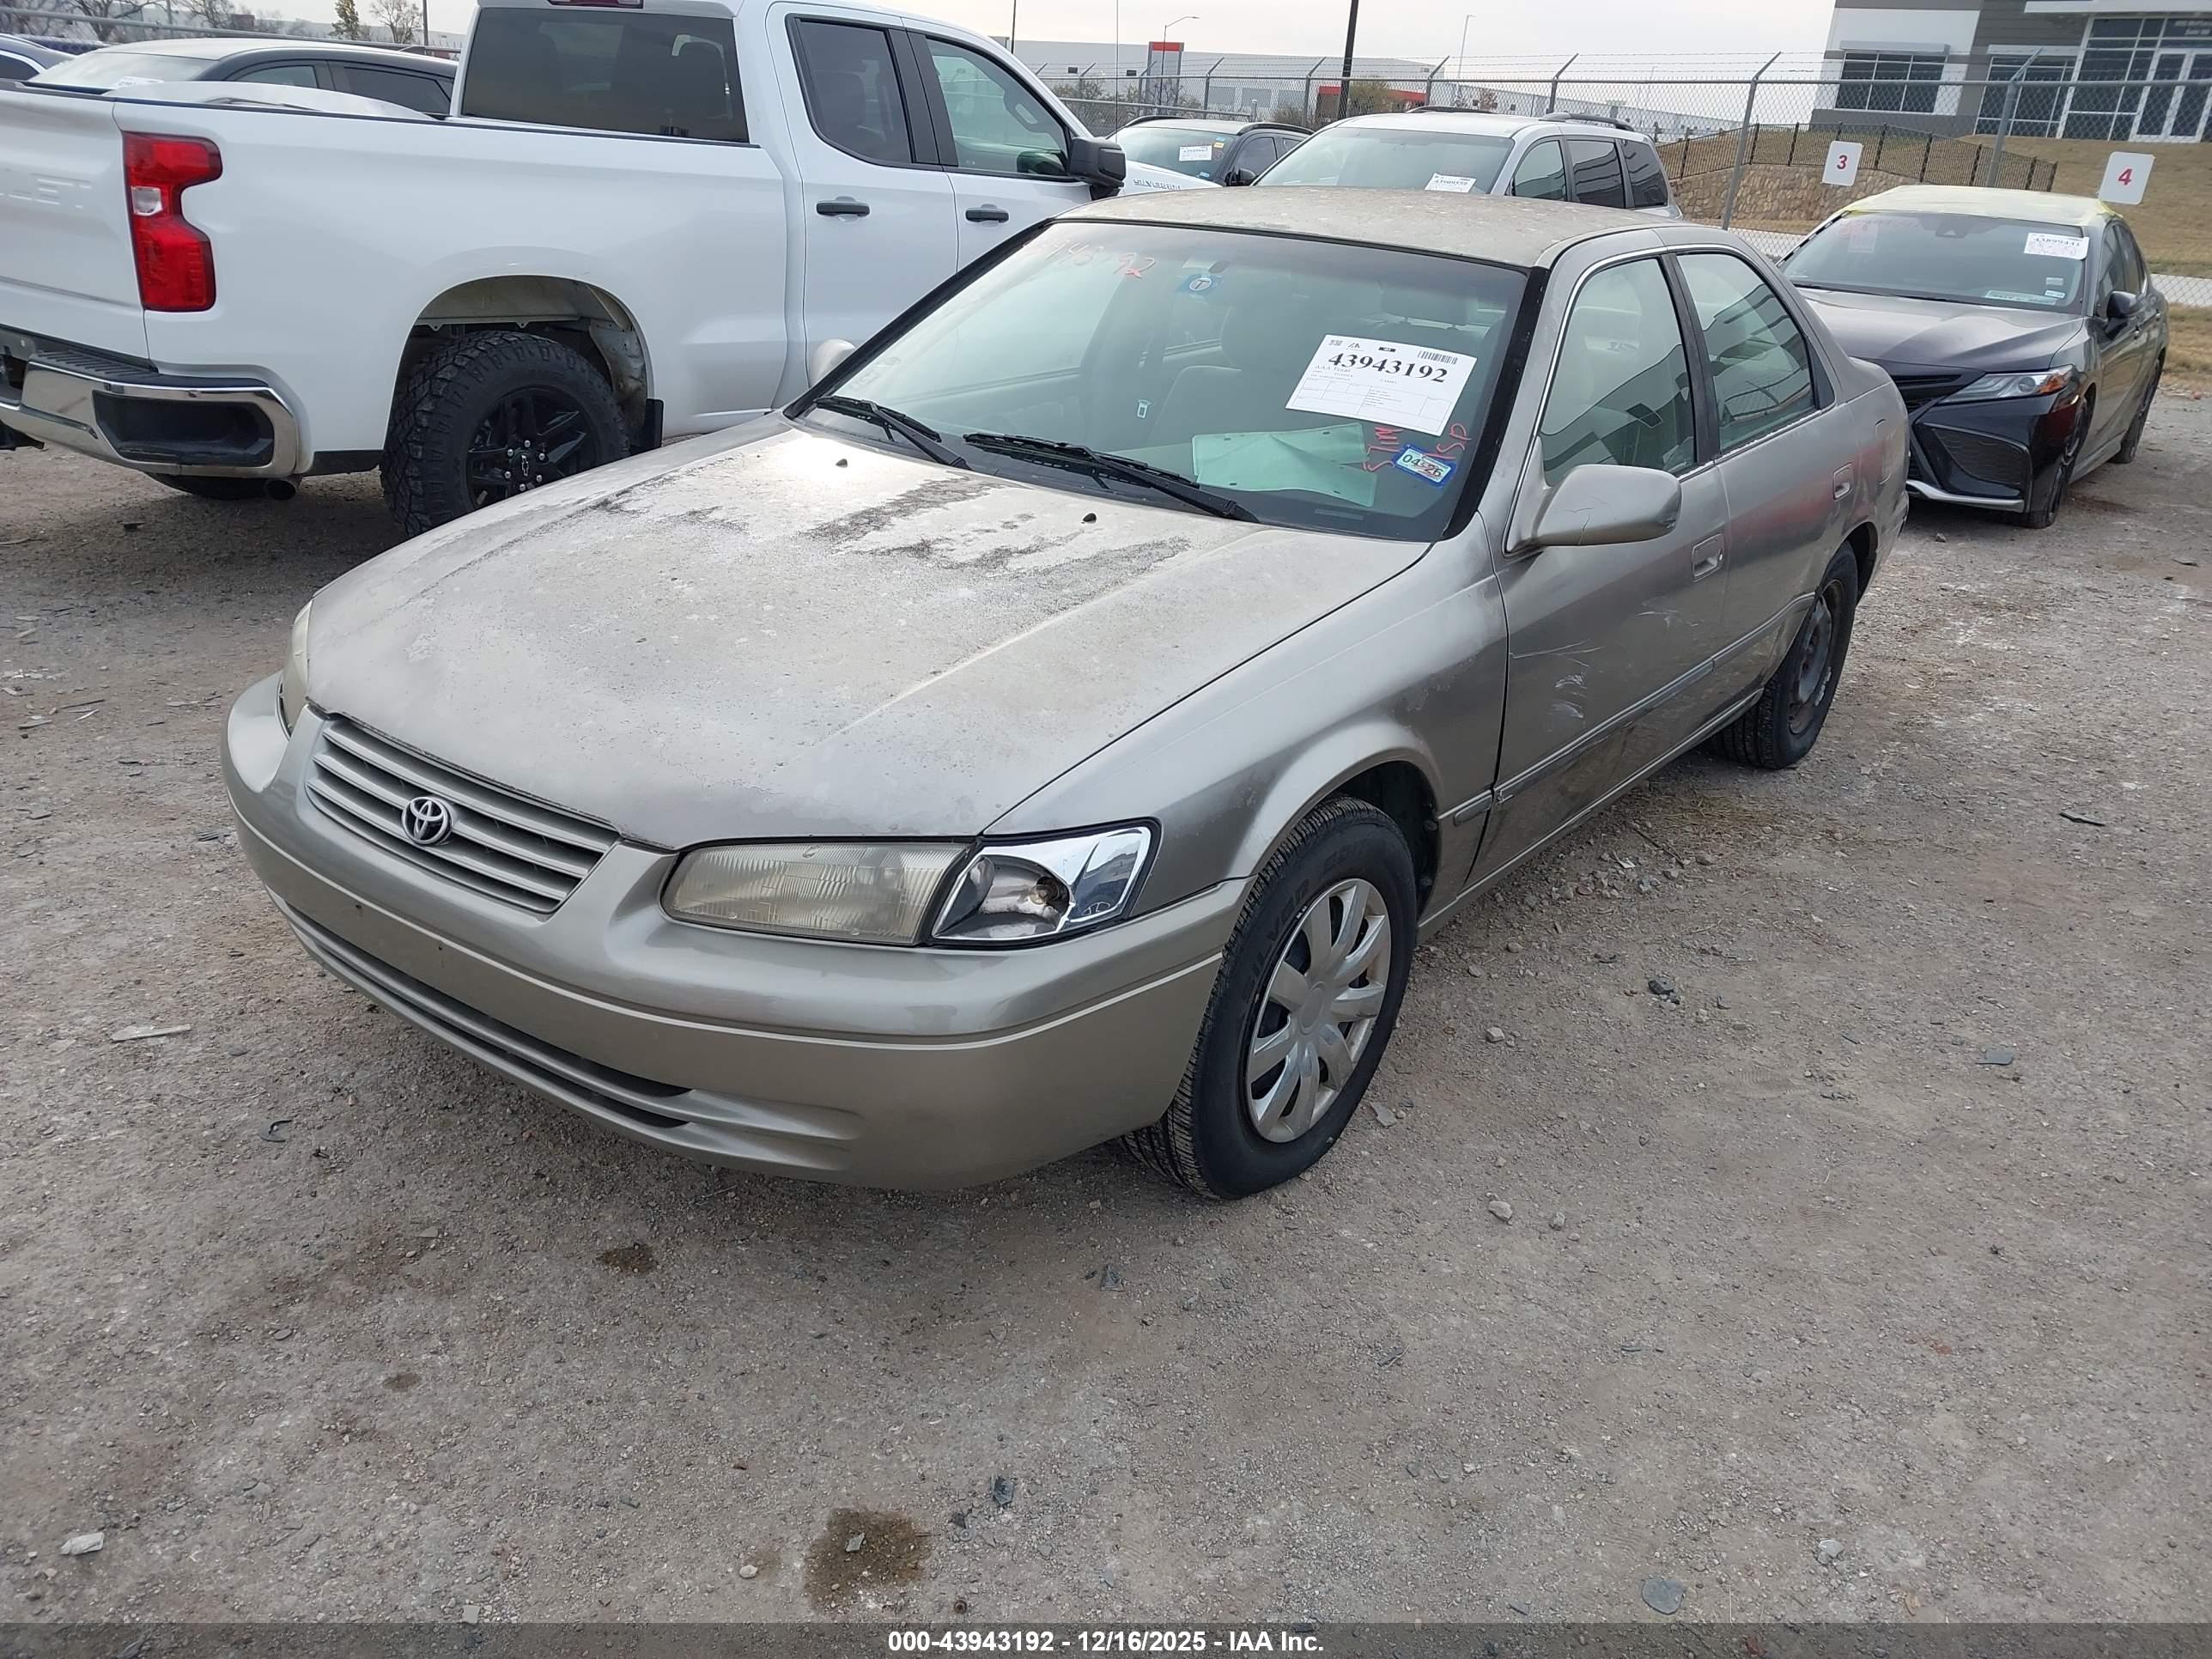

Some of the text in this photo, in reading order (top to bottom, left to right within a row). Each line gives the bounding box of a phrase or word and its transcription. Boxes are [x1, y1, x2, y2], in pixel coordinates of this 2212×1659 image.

[1837, 155, 1848, 170] 3
[2118, 168, 2133, 186] 4
[1328, 352, 1449, 384] 43943192
